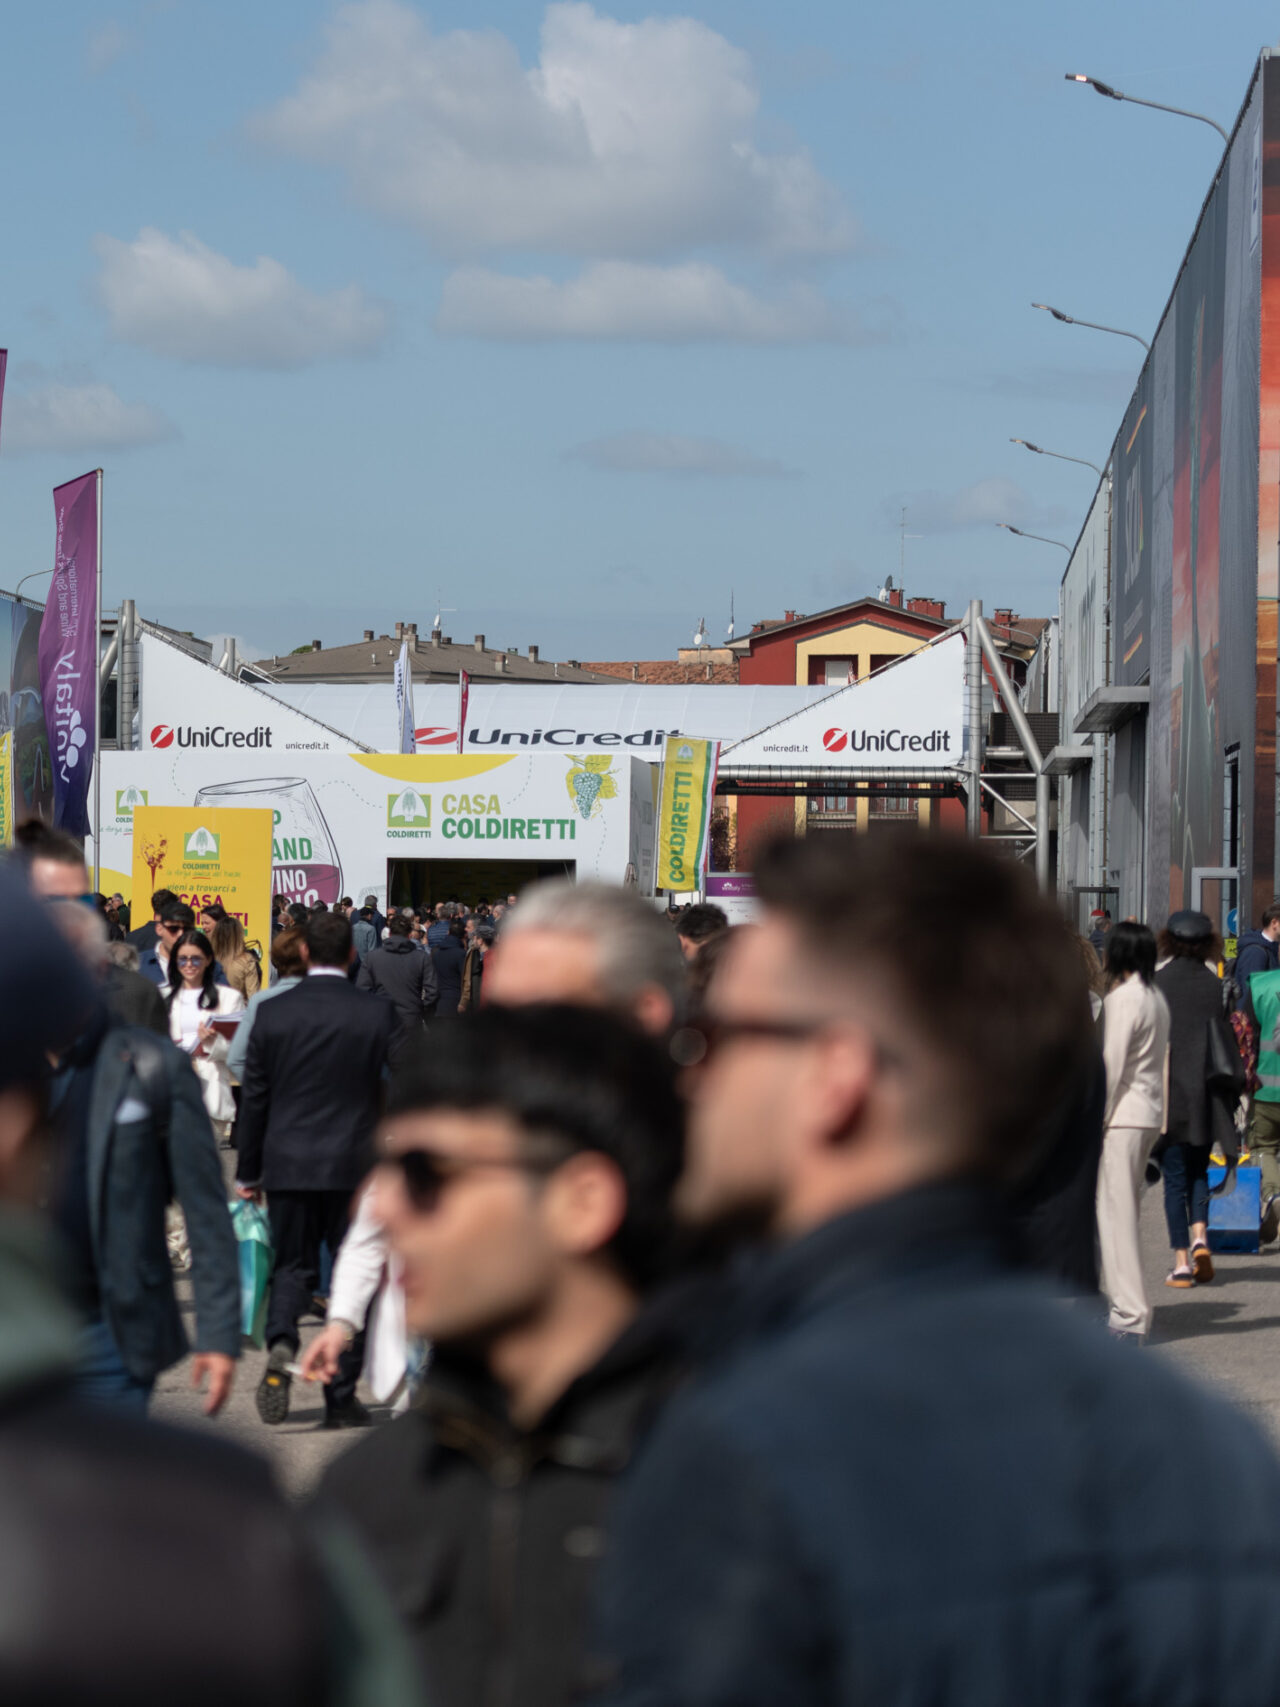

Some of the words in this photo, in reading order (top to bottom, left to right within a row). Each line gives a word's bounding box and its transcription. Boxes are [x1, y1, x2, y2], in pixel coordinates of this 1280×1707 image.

[177, 726, 273, 748] UniCredit
[285, 742, 330, 750] unicredit.it
[851, 729, 951, 752] UniCredit
[763, 744, 809, 753] unicredit.it
[442, 794, 502, 815] CASA
[386, 830, 431, 838] COLDIRETTI
[442, 818, 576, 840] COLDIRETTI
[669, 771, 693, 883] COLDIRETTI
[167, 884, 188, 892] vieni
[196, 884, 229, 893] trovarci
[179, 893, 225, 909] CASA
